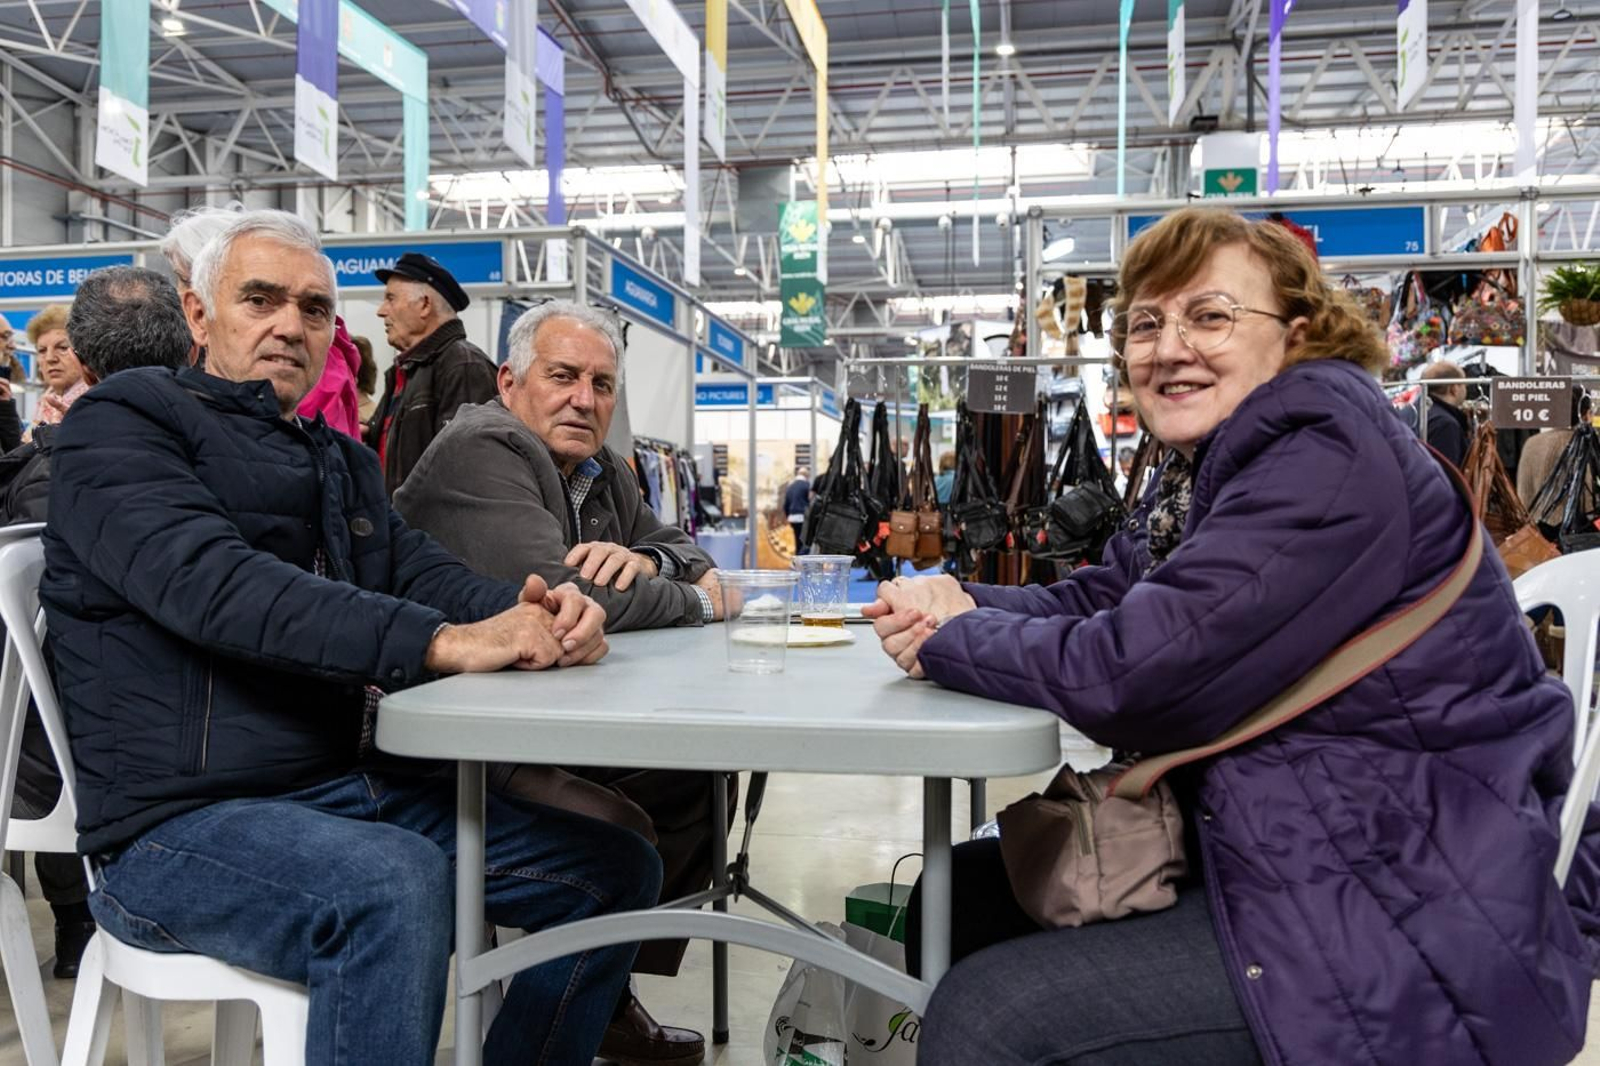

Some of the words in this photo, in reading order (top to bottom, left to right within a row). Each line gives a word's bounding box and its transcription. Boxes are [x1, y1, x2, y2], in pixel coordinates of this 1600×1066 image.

[1405, 241, 1419, 251] 75
[46, 269, 64, 285] DE
[1023, 366, 1036, 374] PIEL
[1497, 380, 1566, 390] BANDOLERAS
[707, 390, 745, 400] PICTURES
[1511, 393, 1526, 402] DE
[1528, 393, 1551, 402] PIEL
[1512, 408, 1534, 422] 10
[1537, 408, 1550, 422] €
